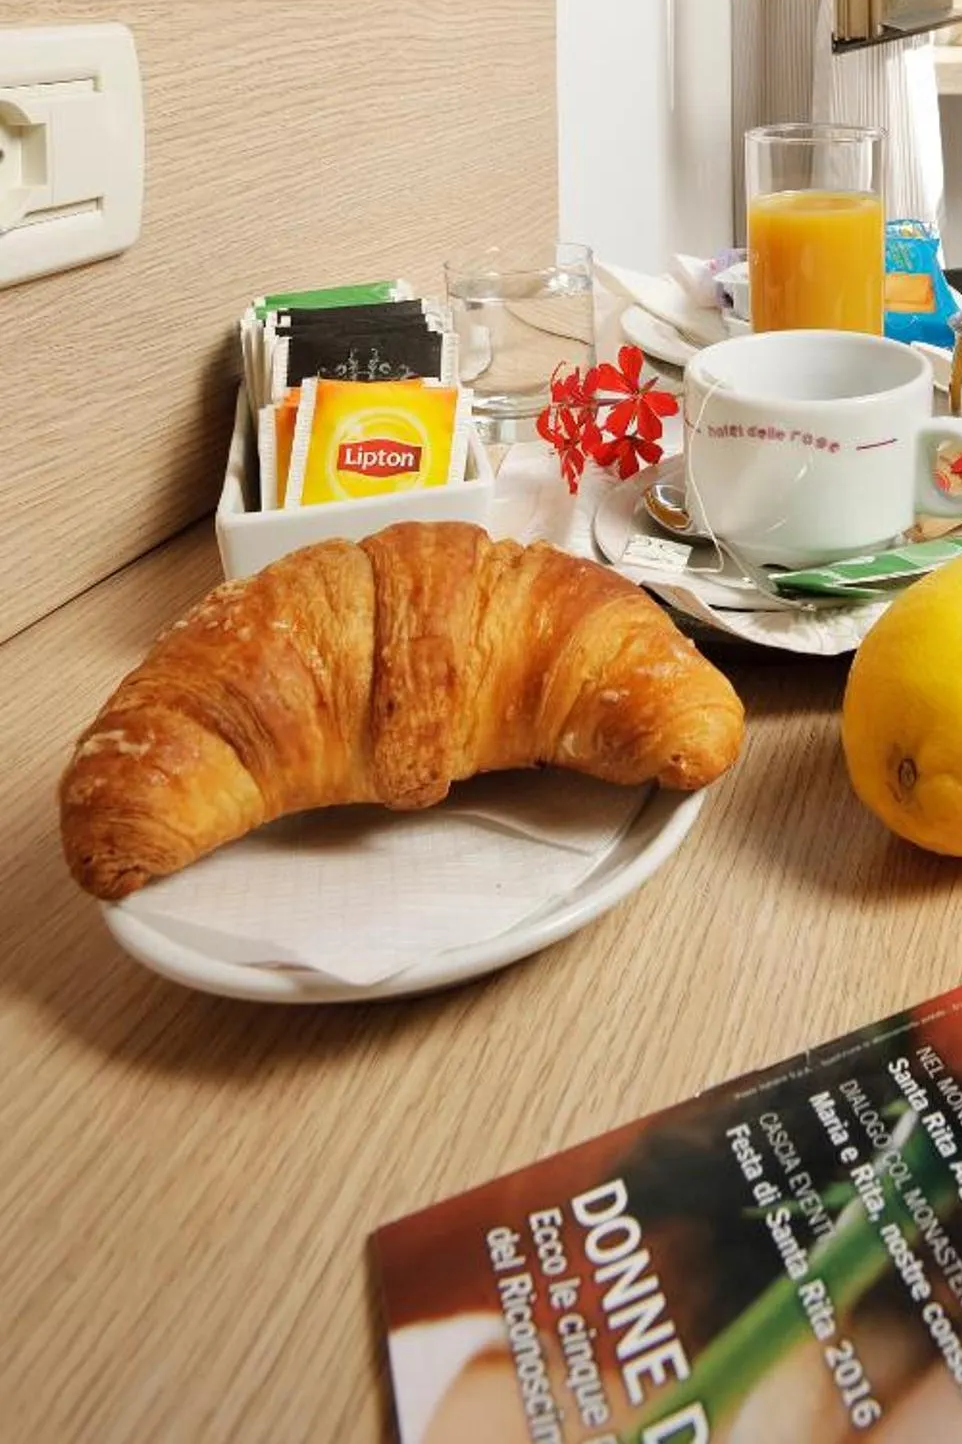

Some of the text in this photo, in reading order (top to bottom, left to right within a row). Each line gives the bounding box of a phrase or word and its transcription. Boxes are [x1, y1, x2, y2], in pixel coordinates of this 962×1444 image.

[344, 446, 416, 468] Lipton
[916, 1045, 942, 1080] NEL
[759, 1112, 801, 1175] CASCIA
[839, 1079, 891, 1148] DIALOGO
[883, 1151, 913, 1191] COL
[889, 1057, 929, 1112] Santa
[922, 1111, 959, 1158] Rita
[809, 1091, 850, 1146] Maria
[840, 1146, 860, 1164] e
[850, 1162, 886, 1222] Rita,
[880, 1223, 932, 1302] nostre
[486, 1226, 526, 1272] del
[529, 1207, 568, 1276] Ecco
[726, 1122, 882, 1429] Festa di Santa Rita 2016
[548, 1277, 581, 1310] le
[571, 1178, 691, 1406] DONNE
[557, 1312, 609, 1427] cinque
